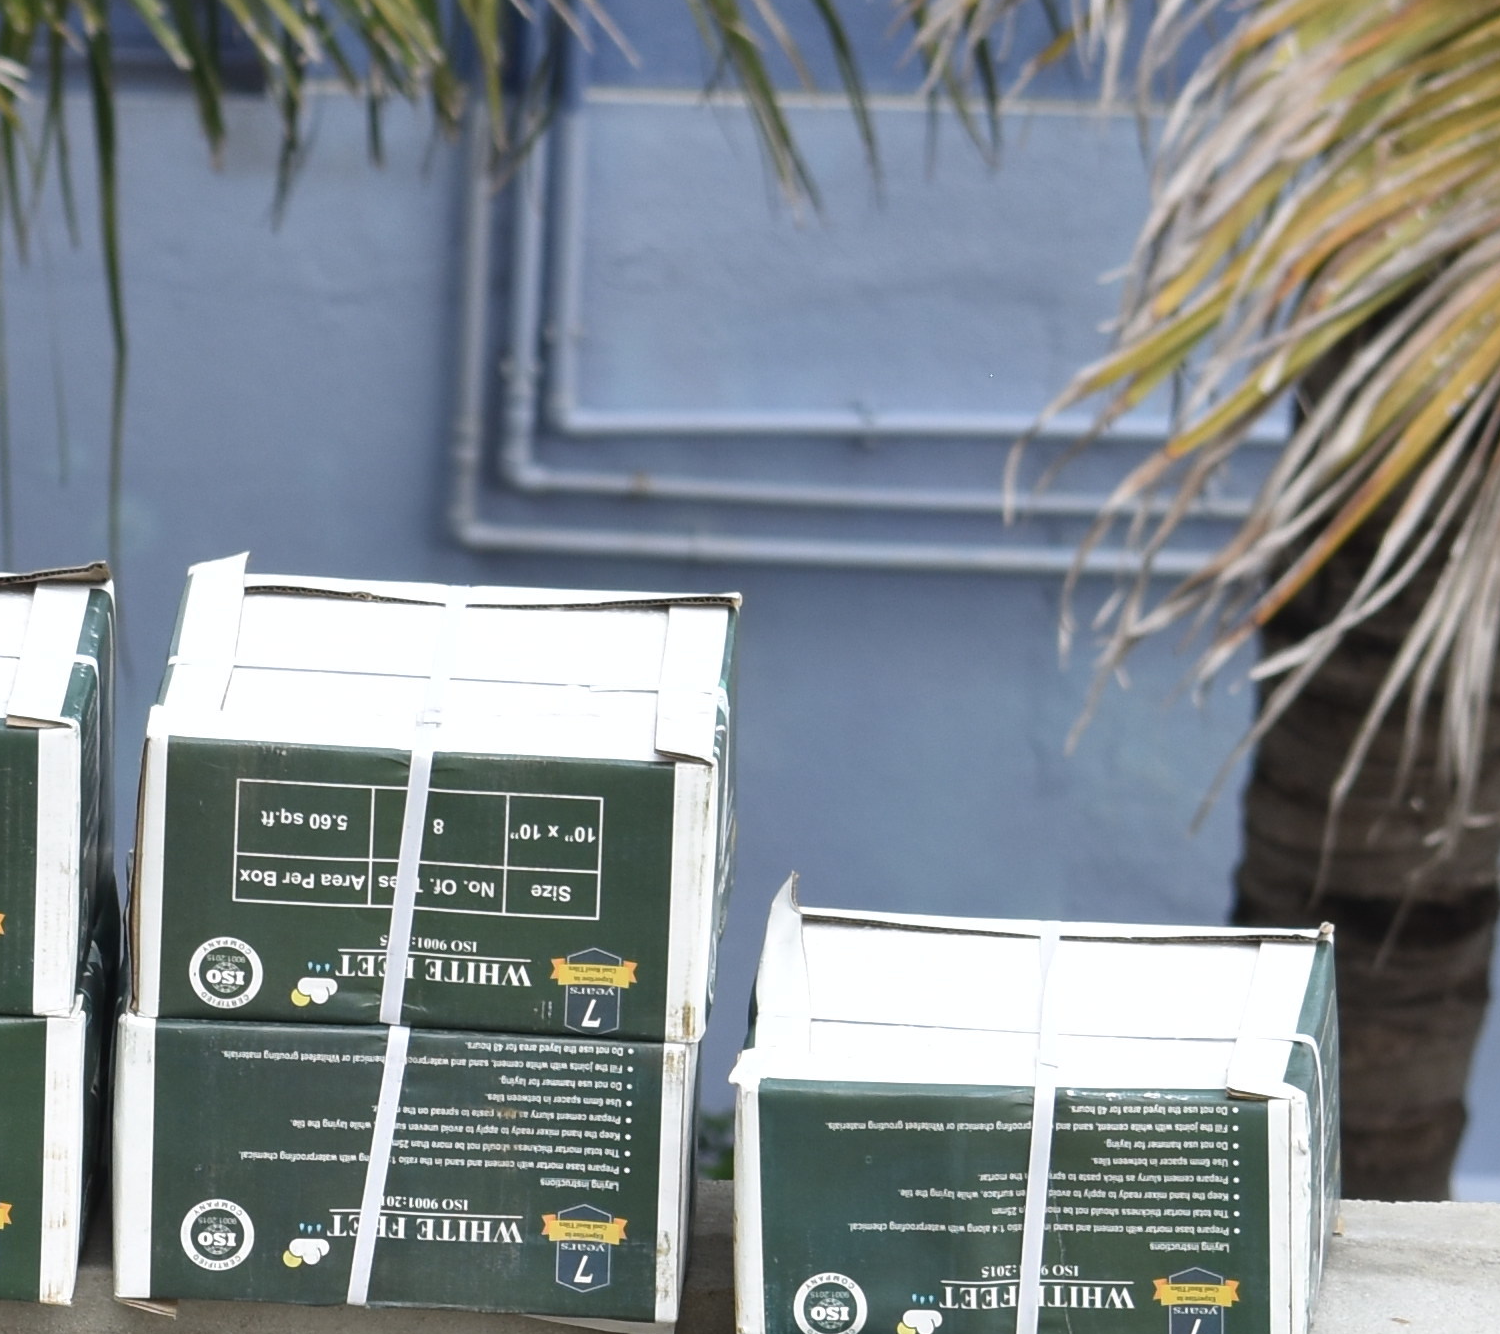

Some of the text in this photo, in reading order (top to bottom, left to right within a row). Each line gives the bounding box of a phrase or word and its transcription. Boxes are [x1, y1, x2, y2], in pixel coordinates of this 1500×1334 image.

[261, 808, 348, 831] 5.60 sq.ft
[239, 869, 365, 890] Area Per Box
[531, 885, 571, 901] Size
[452, 939, 478, 953] ISO
[206, 969, 245, 984] ISO
[425, 957, 532, 987] WHITE
[582, 999, 602, 1027] 7
[442, 1199, 468, 1210] ISO
[197, 1232, 236, 1247] ISO
[416, 1218, 523, 1243] WHITE
[574, 1255, 593, 1283] 7
[939, 1285, 1012, 1309] FEET
[811, 1306, 850, 1321] ISO
